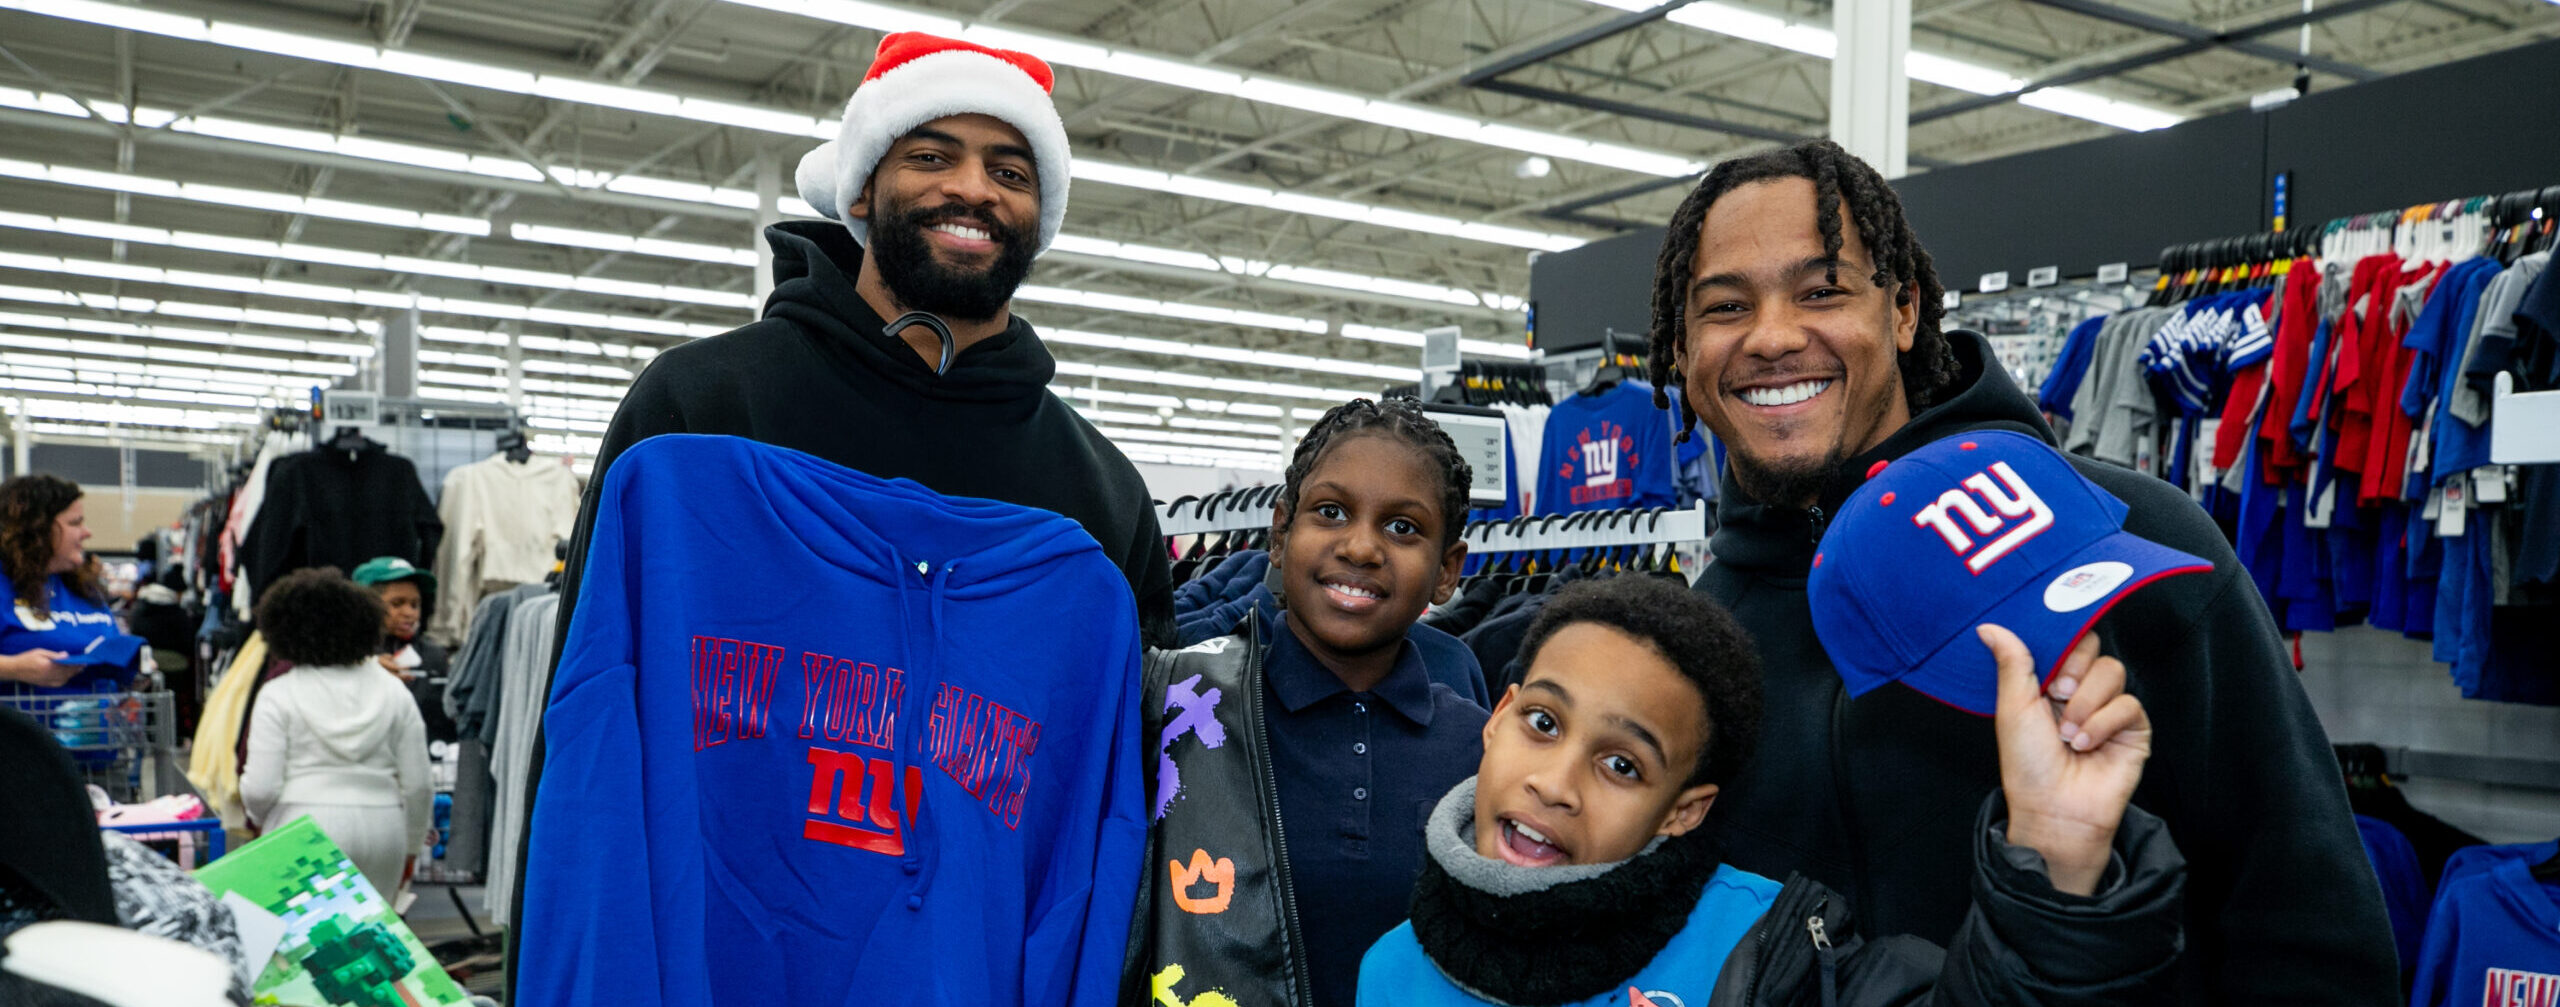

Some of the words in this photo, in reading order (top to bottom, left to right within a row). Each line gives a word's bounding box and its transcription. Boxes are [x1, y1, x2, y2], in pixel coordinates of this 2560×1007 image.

[1559, 426, 1591, 480] NEW
[1600, 420, 1639, 470] YORK
[1581, 437, 1619, 488] ny
[1912, 461, 2055, 577] ny
[691, 635, 785, 752] NEW
[798, 652, 907, 751] YORK
[919, 682, 1042, 832] GIANTS
